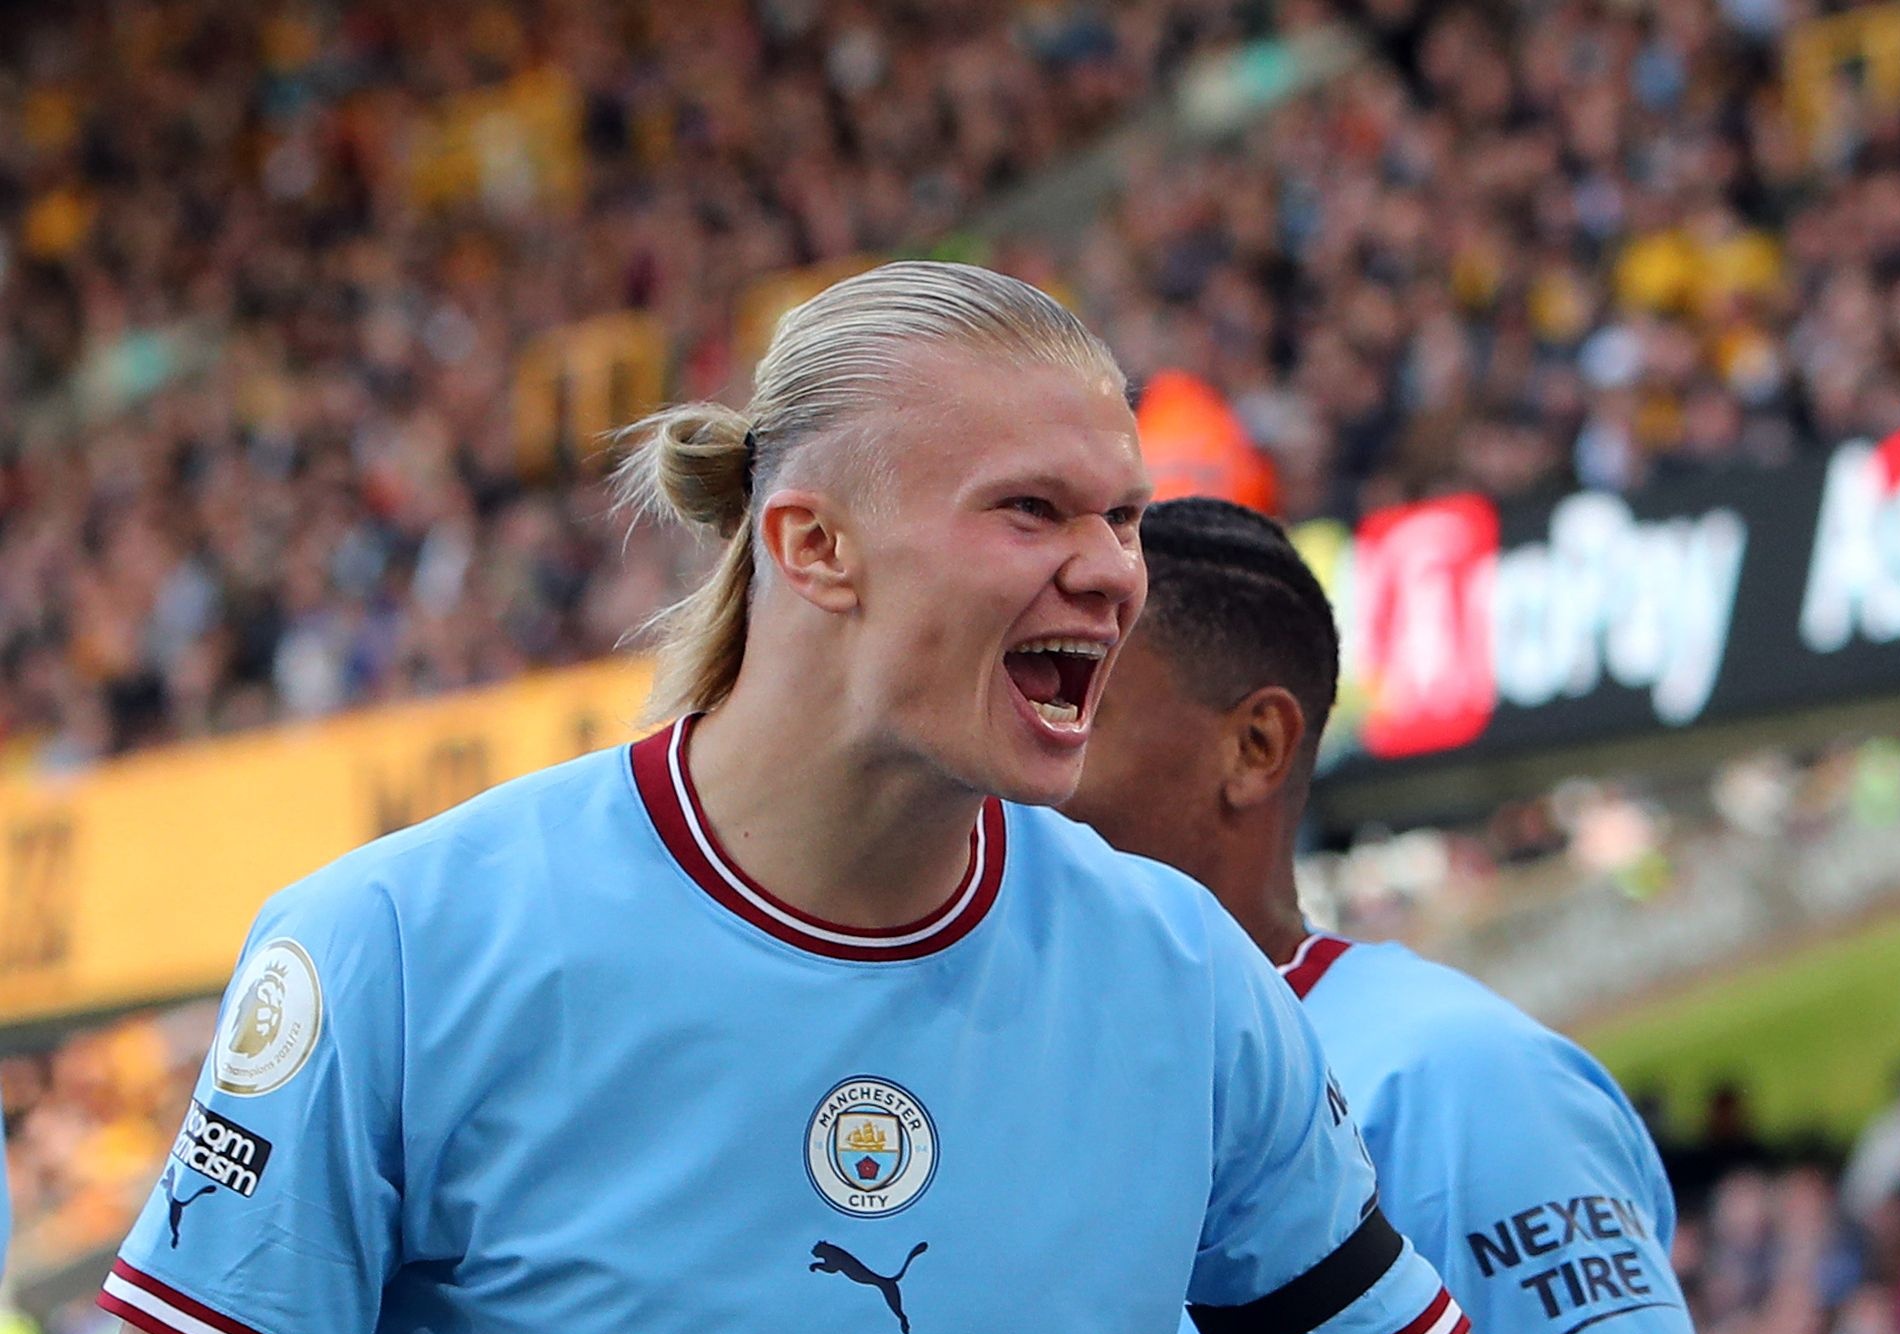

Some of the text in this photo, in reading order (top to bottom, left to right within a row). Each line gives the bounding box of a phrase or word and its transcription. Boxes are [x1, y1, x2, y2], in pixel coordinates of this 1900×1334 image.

[185, 1101, 256, 1166] oom
[819, 1086, 922, 1132] MANCHESTER
[848, 1194, 889, 1208] CITY
[1466, 1195, 1649, 1278] NEXEN
[1521, 1251, 1650, 1319] TIRE
